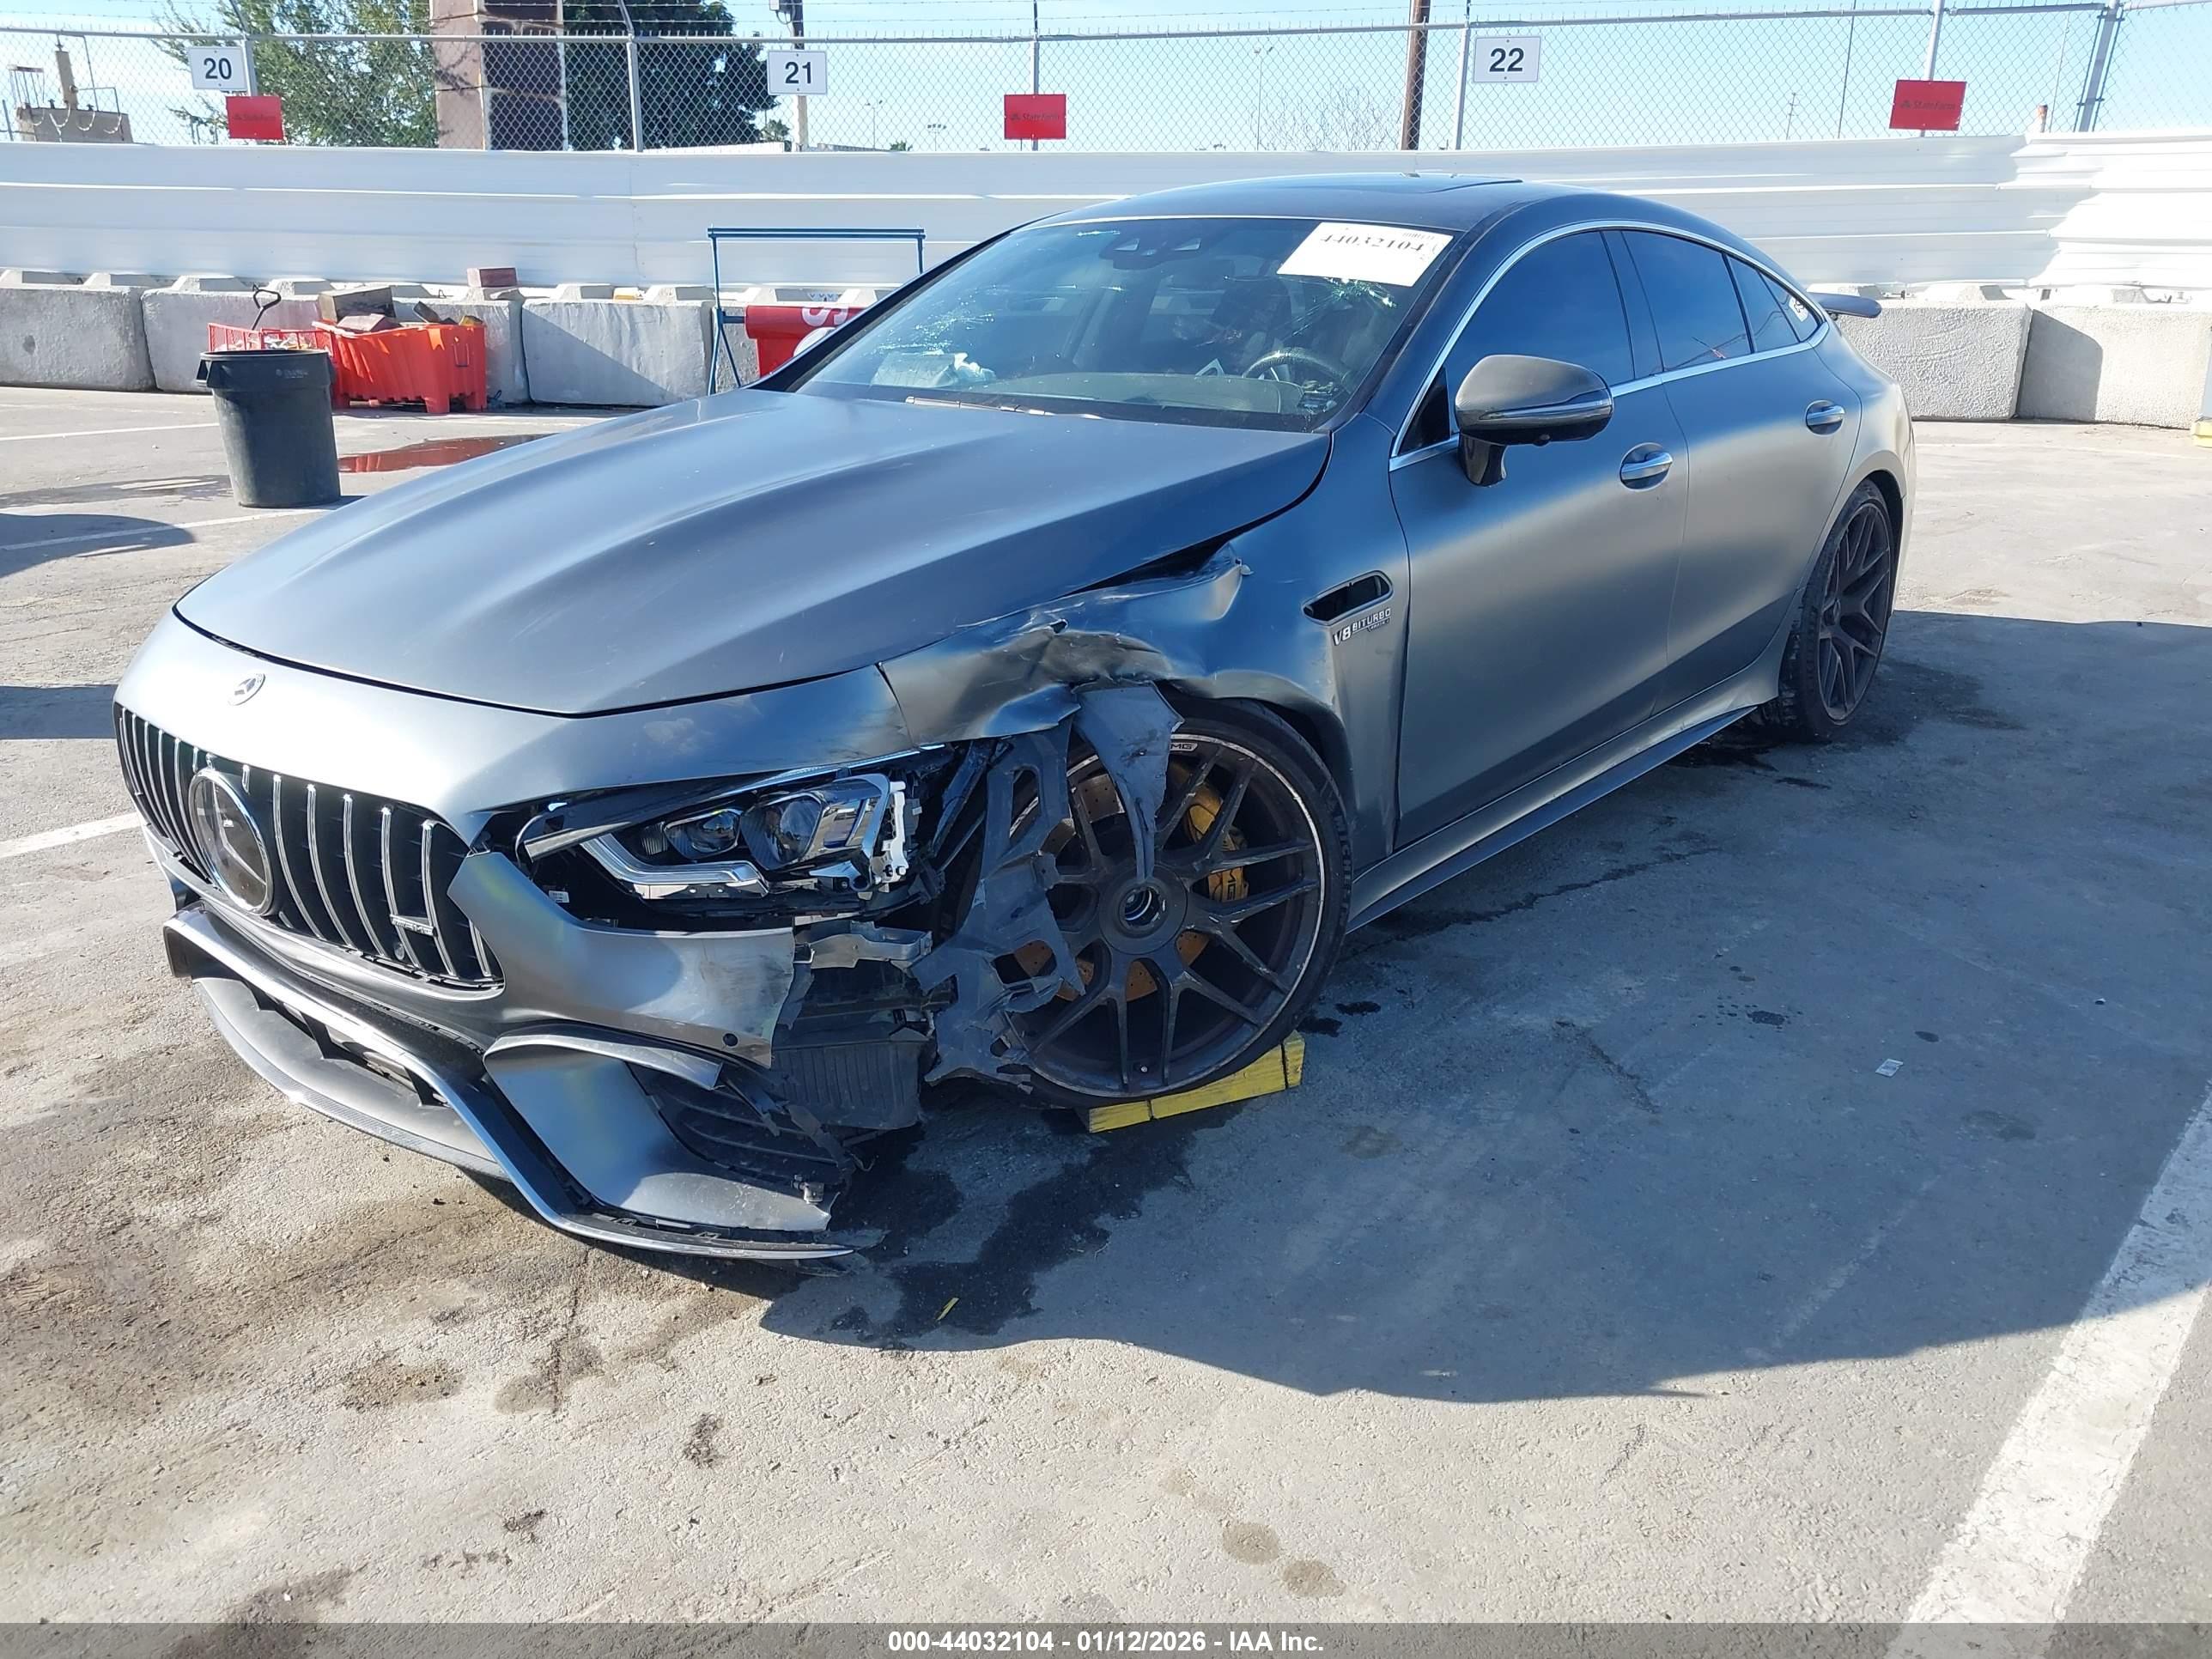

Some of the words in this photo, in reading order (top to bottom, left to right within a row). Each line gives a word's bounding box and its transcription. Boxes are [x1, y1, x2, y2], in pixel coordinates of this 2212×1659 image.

[204, 58, 232, 80] 20
[1489, 47, 1524, 72] 22
[785, 61, 811, 84] 21
[1334, 626, 1351, 646] V8
[1352, 608, 1391, 632] BITURBO
[1227, 869, 1237, 901] MG
